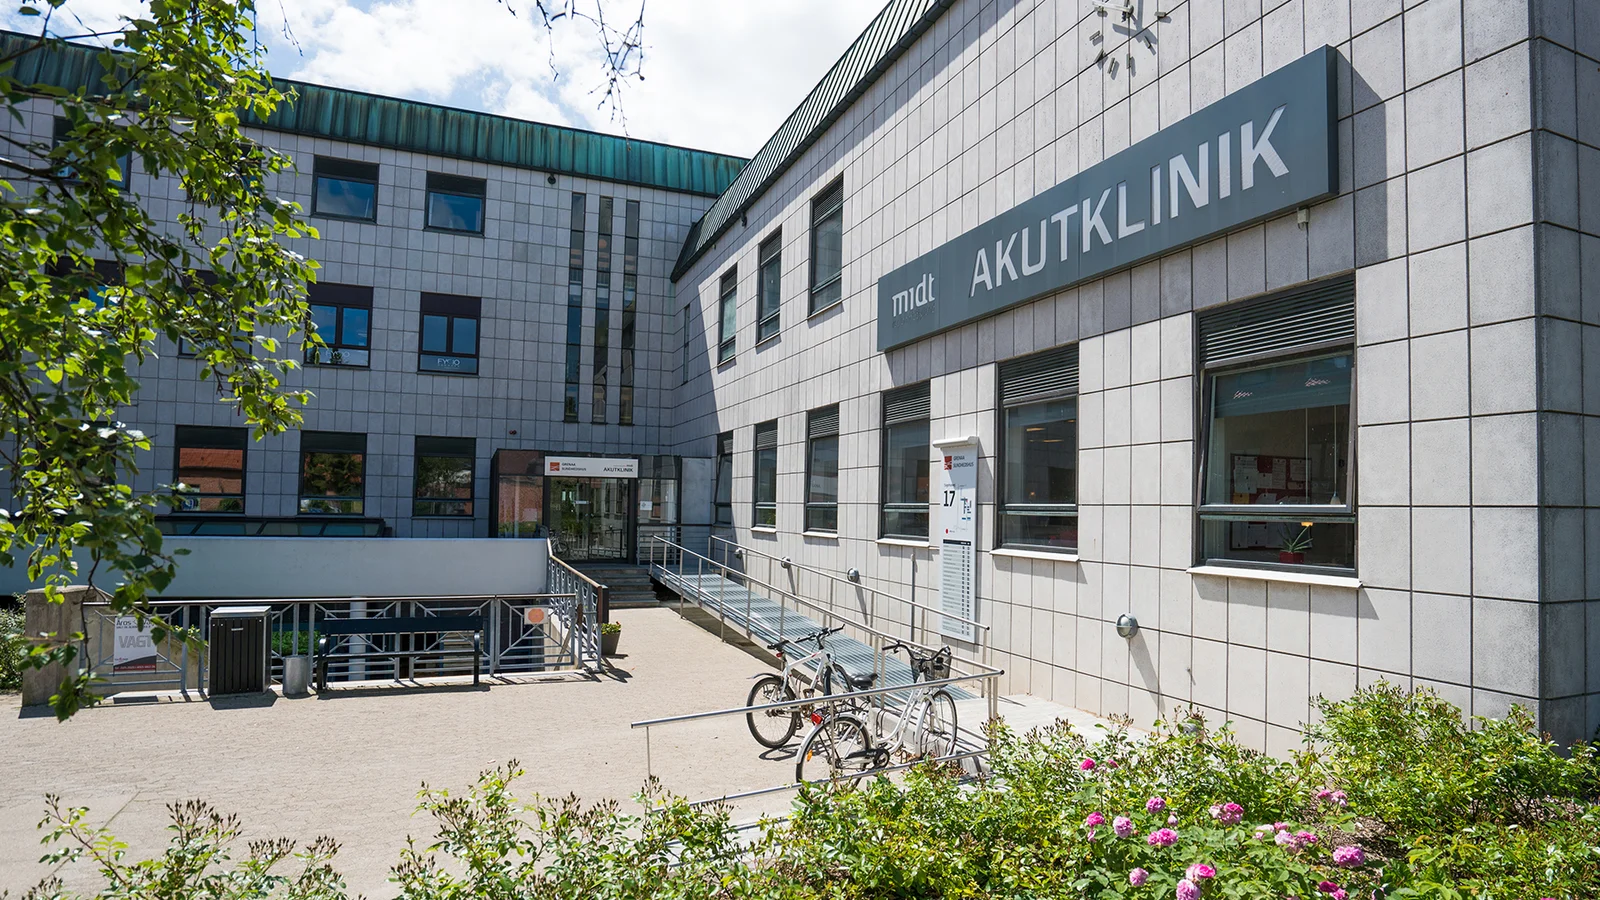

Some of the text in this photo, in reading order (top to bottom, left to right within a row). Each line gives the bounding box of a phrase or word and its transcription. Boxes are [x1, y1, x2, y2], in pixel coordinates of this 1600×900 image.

[968, 103, 1290, 298] AKUTKLINIK
[891, 272, 936, 318] midt
[944, 491, 955, 506] 17
